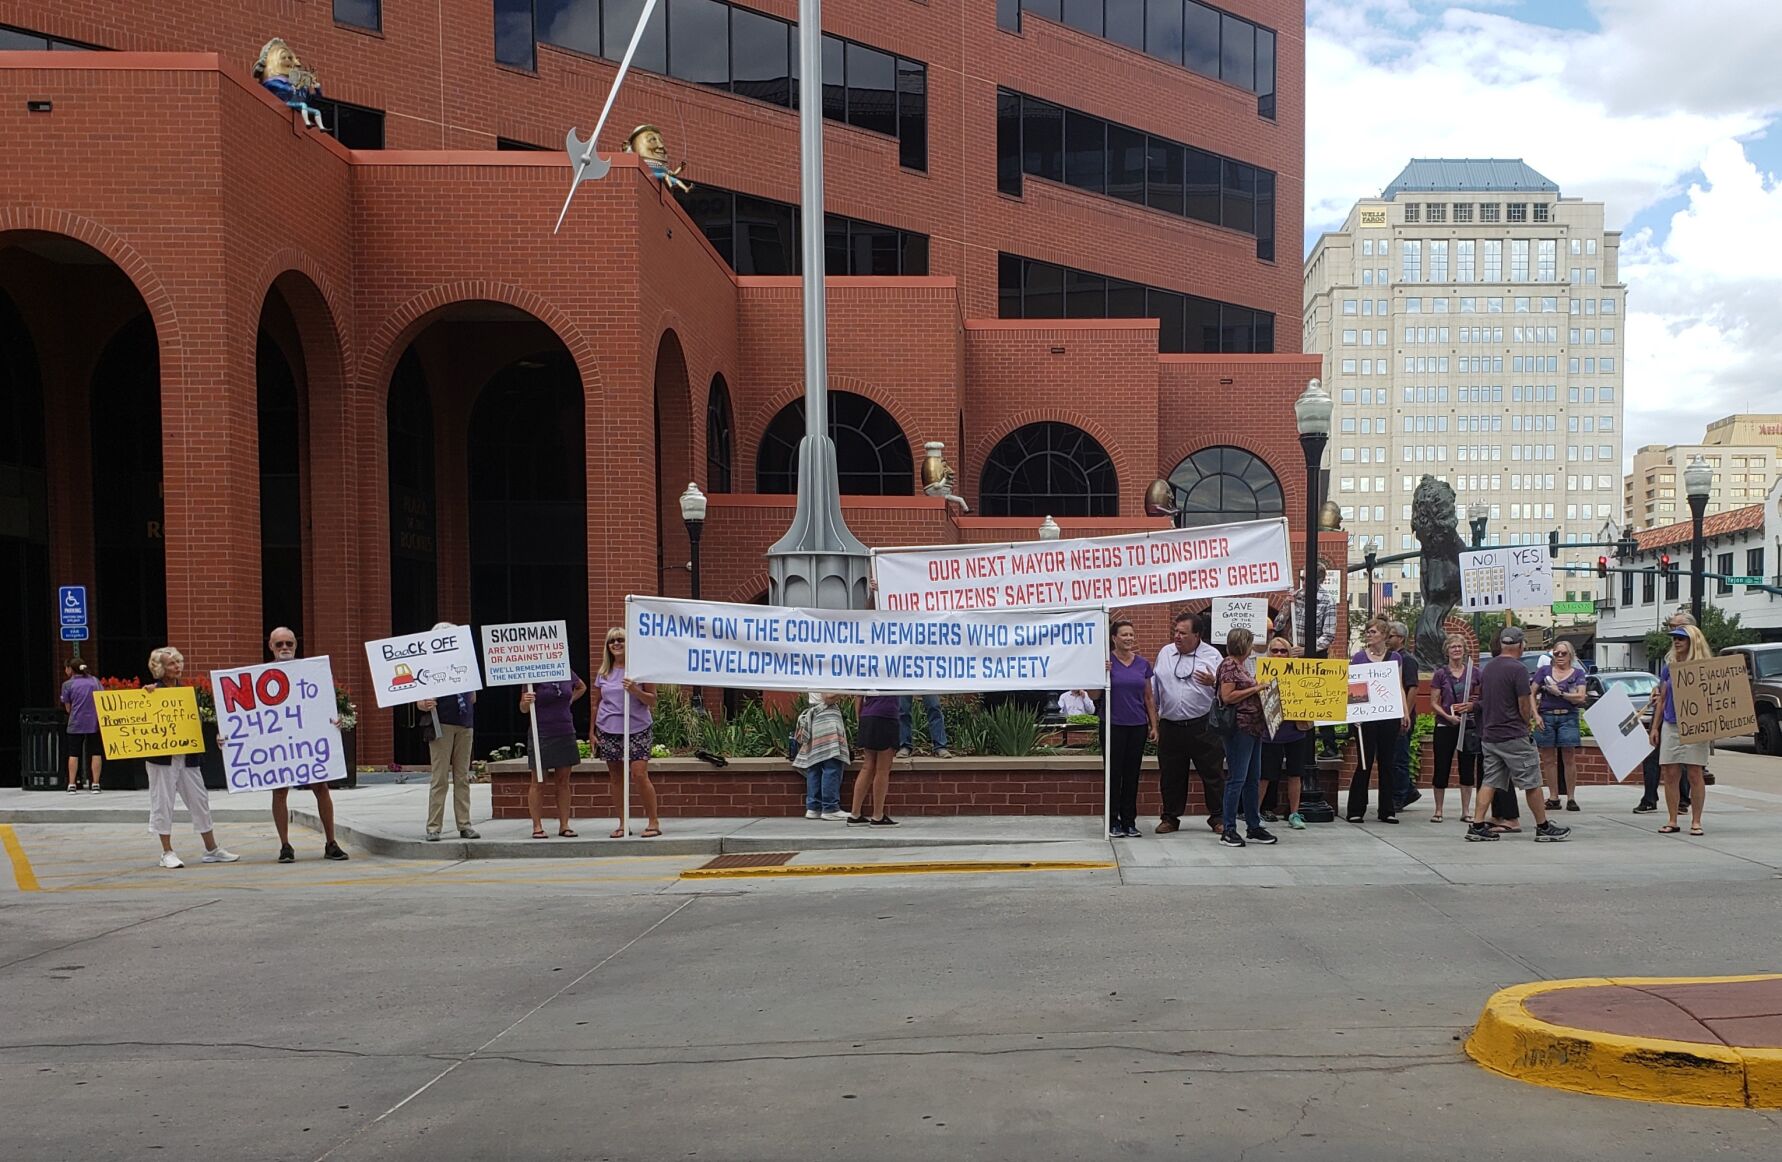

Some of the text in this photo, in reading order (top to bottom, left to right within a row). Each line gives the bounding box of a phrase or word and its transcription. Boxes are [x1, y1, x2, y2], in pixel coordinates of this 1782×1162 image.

[929, 537, 1230, 581] OUR NEXT MAYOR NEEDS TO CONSIDER
[1472, 553, 1497, 567] NO!
[1512, 548, 1544, 565] YES!
[888, 561, 1280, 611] OUR CITIZENS' SAFETY, OVER DEVELOPERS' GREED
[1228, 602, 1253, 611] SAVE
[491, 625, 558, 643] SKORMAN
[639, 612, 1096, 647] SHAME ON THE COUNCIL MEMBERS WHO SUPPORT
[430, 635, 458, 651] OFF
[488, 642, 565, 655] ARE YOU WITH US
[491, 651, 563, 664] OR AGAINST US?
[688, 648, 1050, 678] DEVELOPMENT OVER WESTSIDE SAFETY
[515, 663, 556, 672] REMEMBER
[1261, 661, 1278, 676] No
[1368, 667, 1392, 679] this?
[1300, 678, 1321, 689] and
[1677, 666, 1747, 688] NO EVACUATION
[220, 668, 318, 713] NO to
[1305, 690, 1322, 698] with
[1370, 679, 1394, 702] FIRE
[1699, 680, 1730, 697] PLAN
[101, 694, 184, 712] Where's our
[1351, 704, 1395, 716] 26, 2012
[1680, 697, 1737, 718] NO HIGH
[153, 708, 197, 724] Traffic
[227, 704, 303, 739] 2424
[119, 722, 177, 737] Study?
[1680, 714, 1756, 736] DENSITY BUILDING
[108, 738, 198, 756] Mt. Shadows
[227, 736, 330, 768] Zoning
[231, 763, 329, 788] Change
